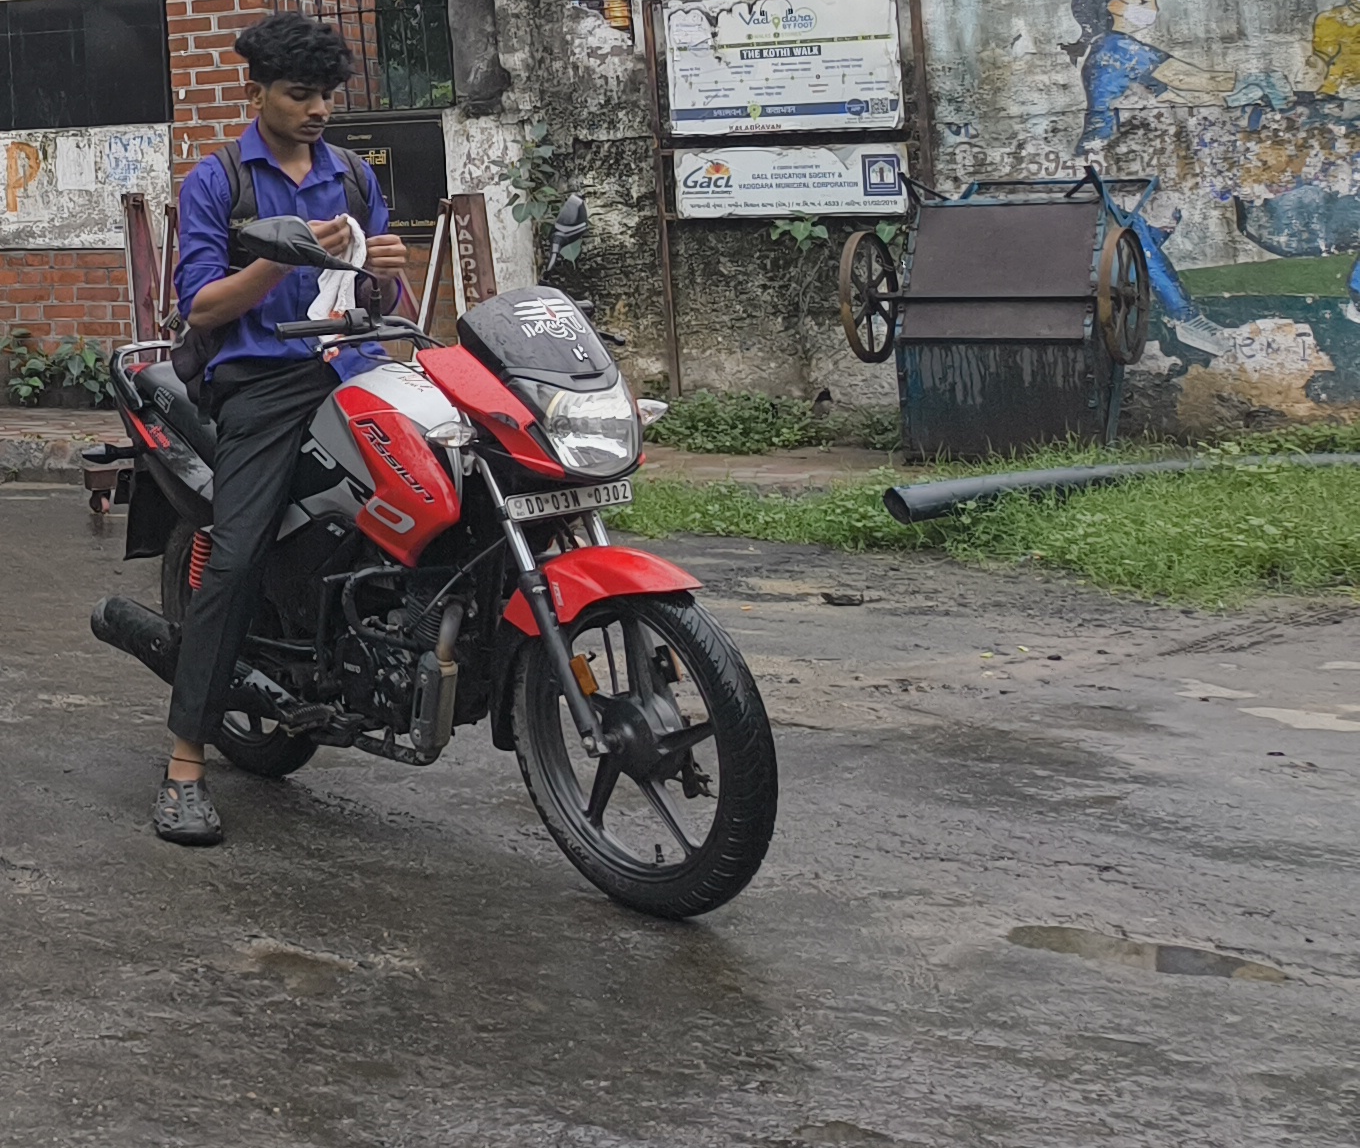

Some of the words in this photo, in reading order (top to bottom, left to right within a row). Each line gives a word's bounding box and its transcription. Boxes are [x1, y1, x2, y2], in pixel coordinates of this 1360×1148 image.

[742, 49, 761, 60] THE
[763, 47, 791, 58] KOTHI
[792, 45, 819, 56] WALK
[770, 171, 807, 180] EDUCATION
[808, 170, 836, 179] SOCIETY
[738, 181, 773, 190] VADODARA
[812, 180, 859, 188] CORPORATION
[411, 217, 436, 227] Limite
